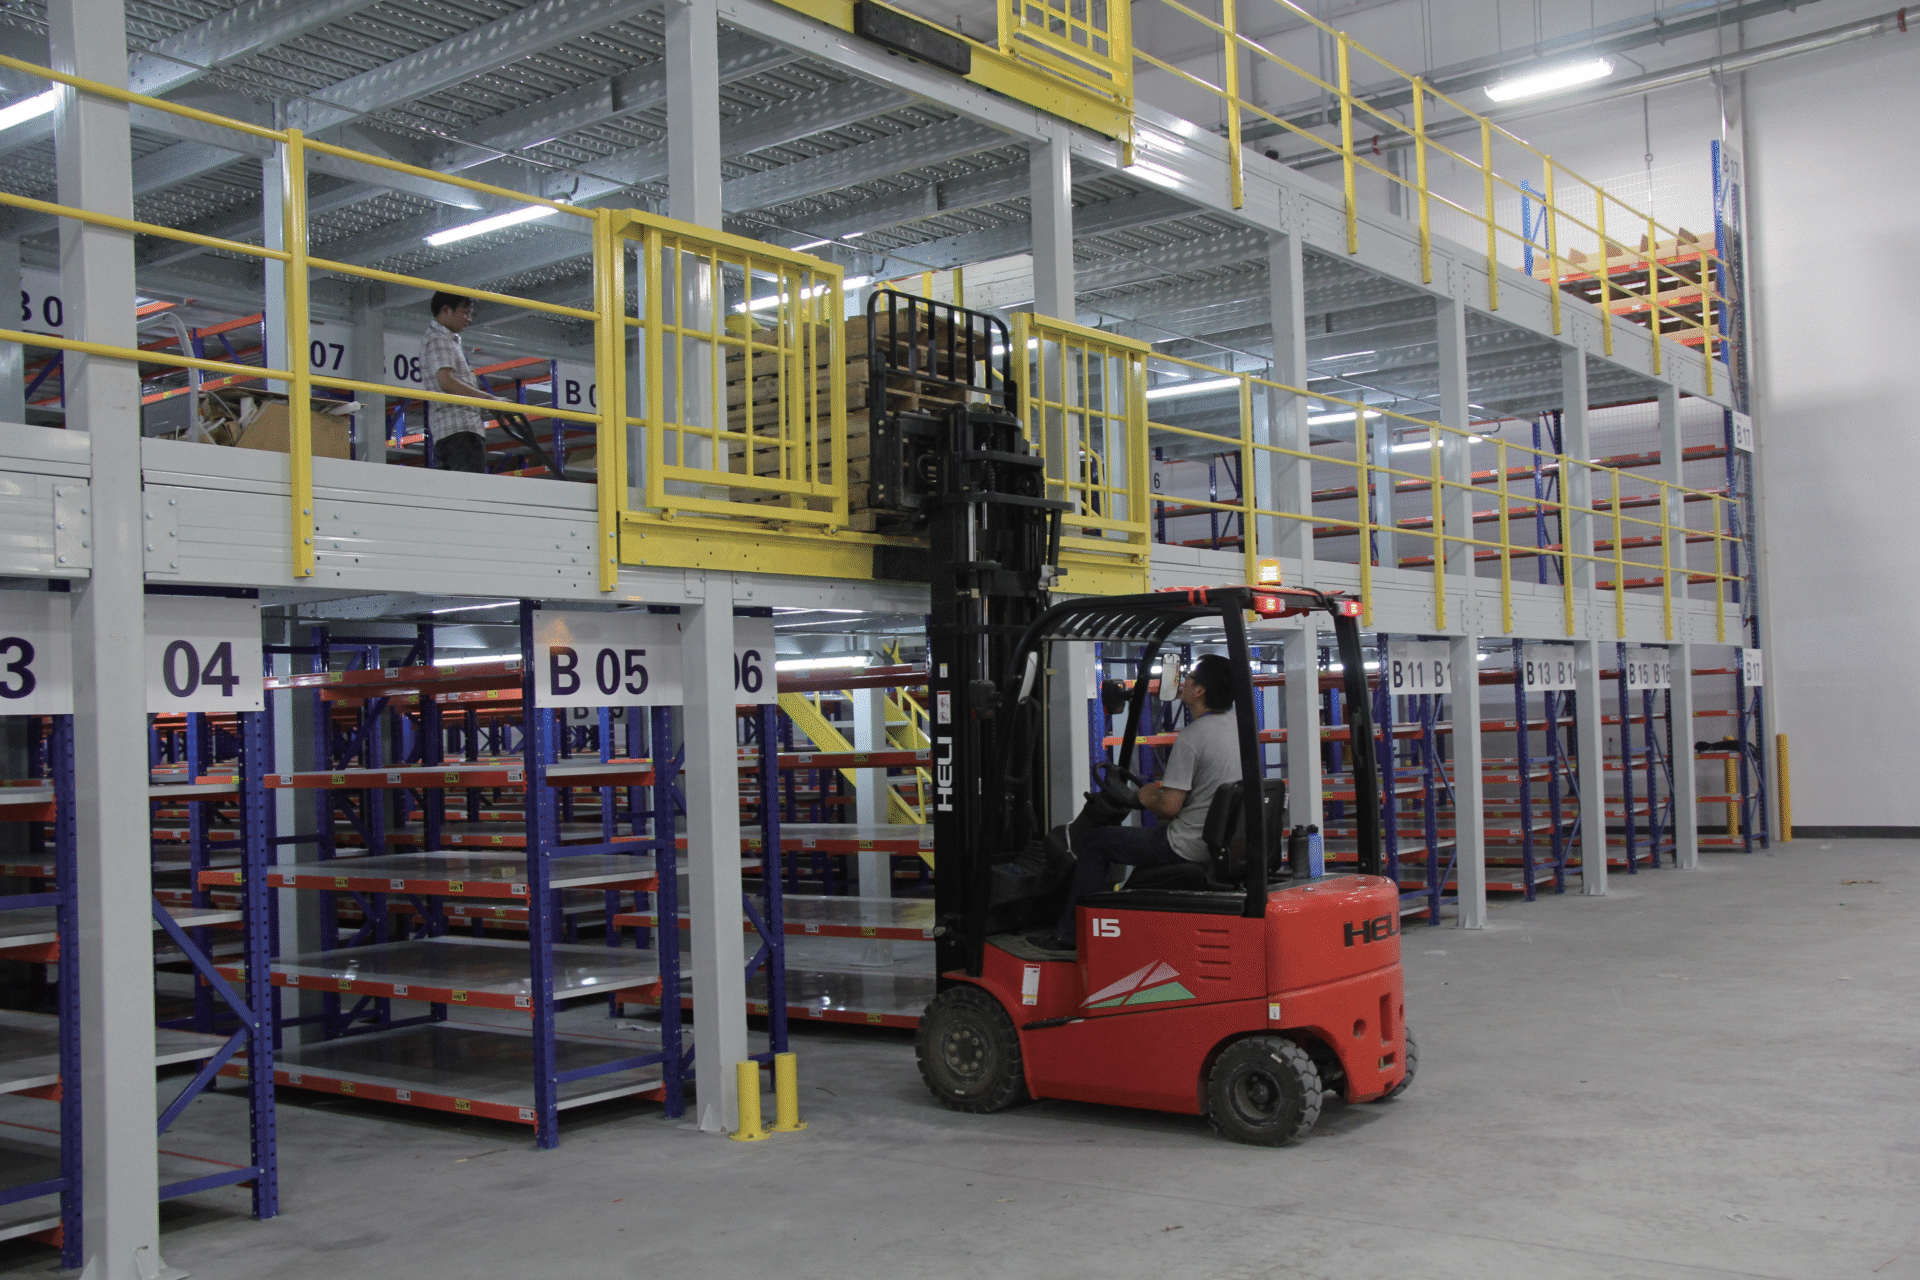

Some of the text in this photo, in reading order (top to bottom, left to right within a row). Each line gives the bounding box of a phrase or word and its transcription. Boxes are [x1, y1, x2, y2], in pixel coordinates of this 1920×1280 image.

[43, 296, 63, 327] 0
[310, 340, 345, 371] 07
[565, 380, 582, 405] B
[1737, 425, 1742, 443] B
[1153, 472, 1161, 489] 6
[0, 637, 37, 699] 3
[163, 639, 240, 697] 04
[549, 646, 649, 696] B 05
[734, 649, 763, 694] 6
[1393, 661, 1403, 688] B
[1407, 661, 1424, 688] 11
[1434, 660, 1444, 688] B
[1526, 661, 1535, 686] B
[1538, 661, 1551, 686] 13
[1557, 661, 1566, 685] B
[1628, 663, 1636, 685] B
[1638, 663, 1649, 685] 15
[1653, 663, 1660, 684] B
[1746, 662, 1759, 681] B 17
[937, 736, 953, 812] HELI
[1092, 918, 1121, 938] 15
[1344, 913, 1399, 947] HEL
